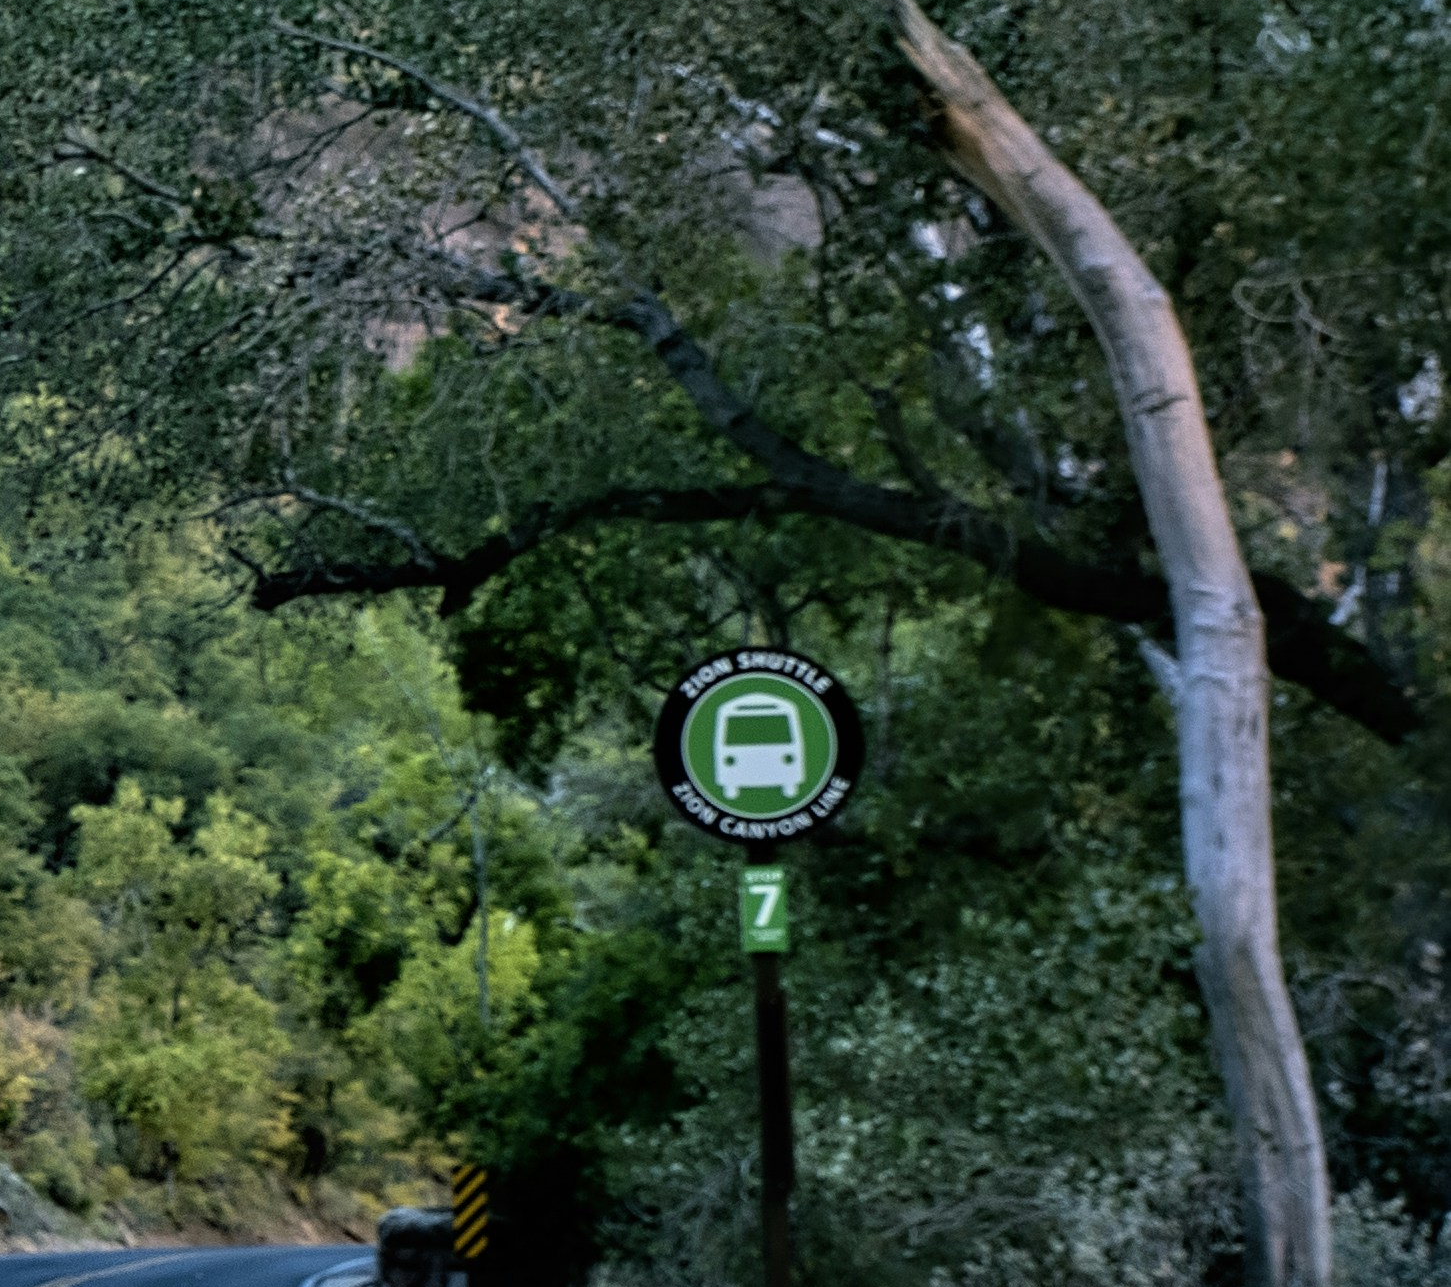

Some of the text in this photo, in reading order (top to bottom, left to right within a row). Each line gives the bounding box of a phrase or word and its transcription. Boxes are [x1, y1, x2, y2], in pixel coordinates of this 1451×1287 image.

[679, 651, 833, 700] ZION SHUTTLE
[672, 775, 851, 839] ZION CANYON LINE
[748, 884, 781, 927] 7
